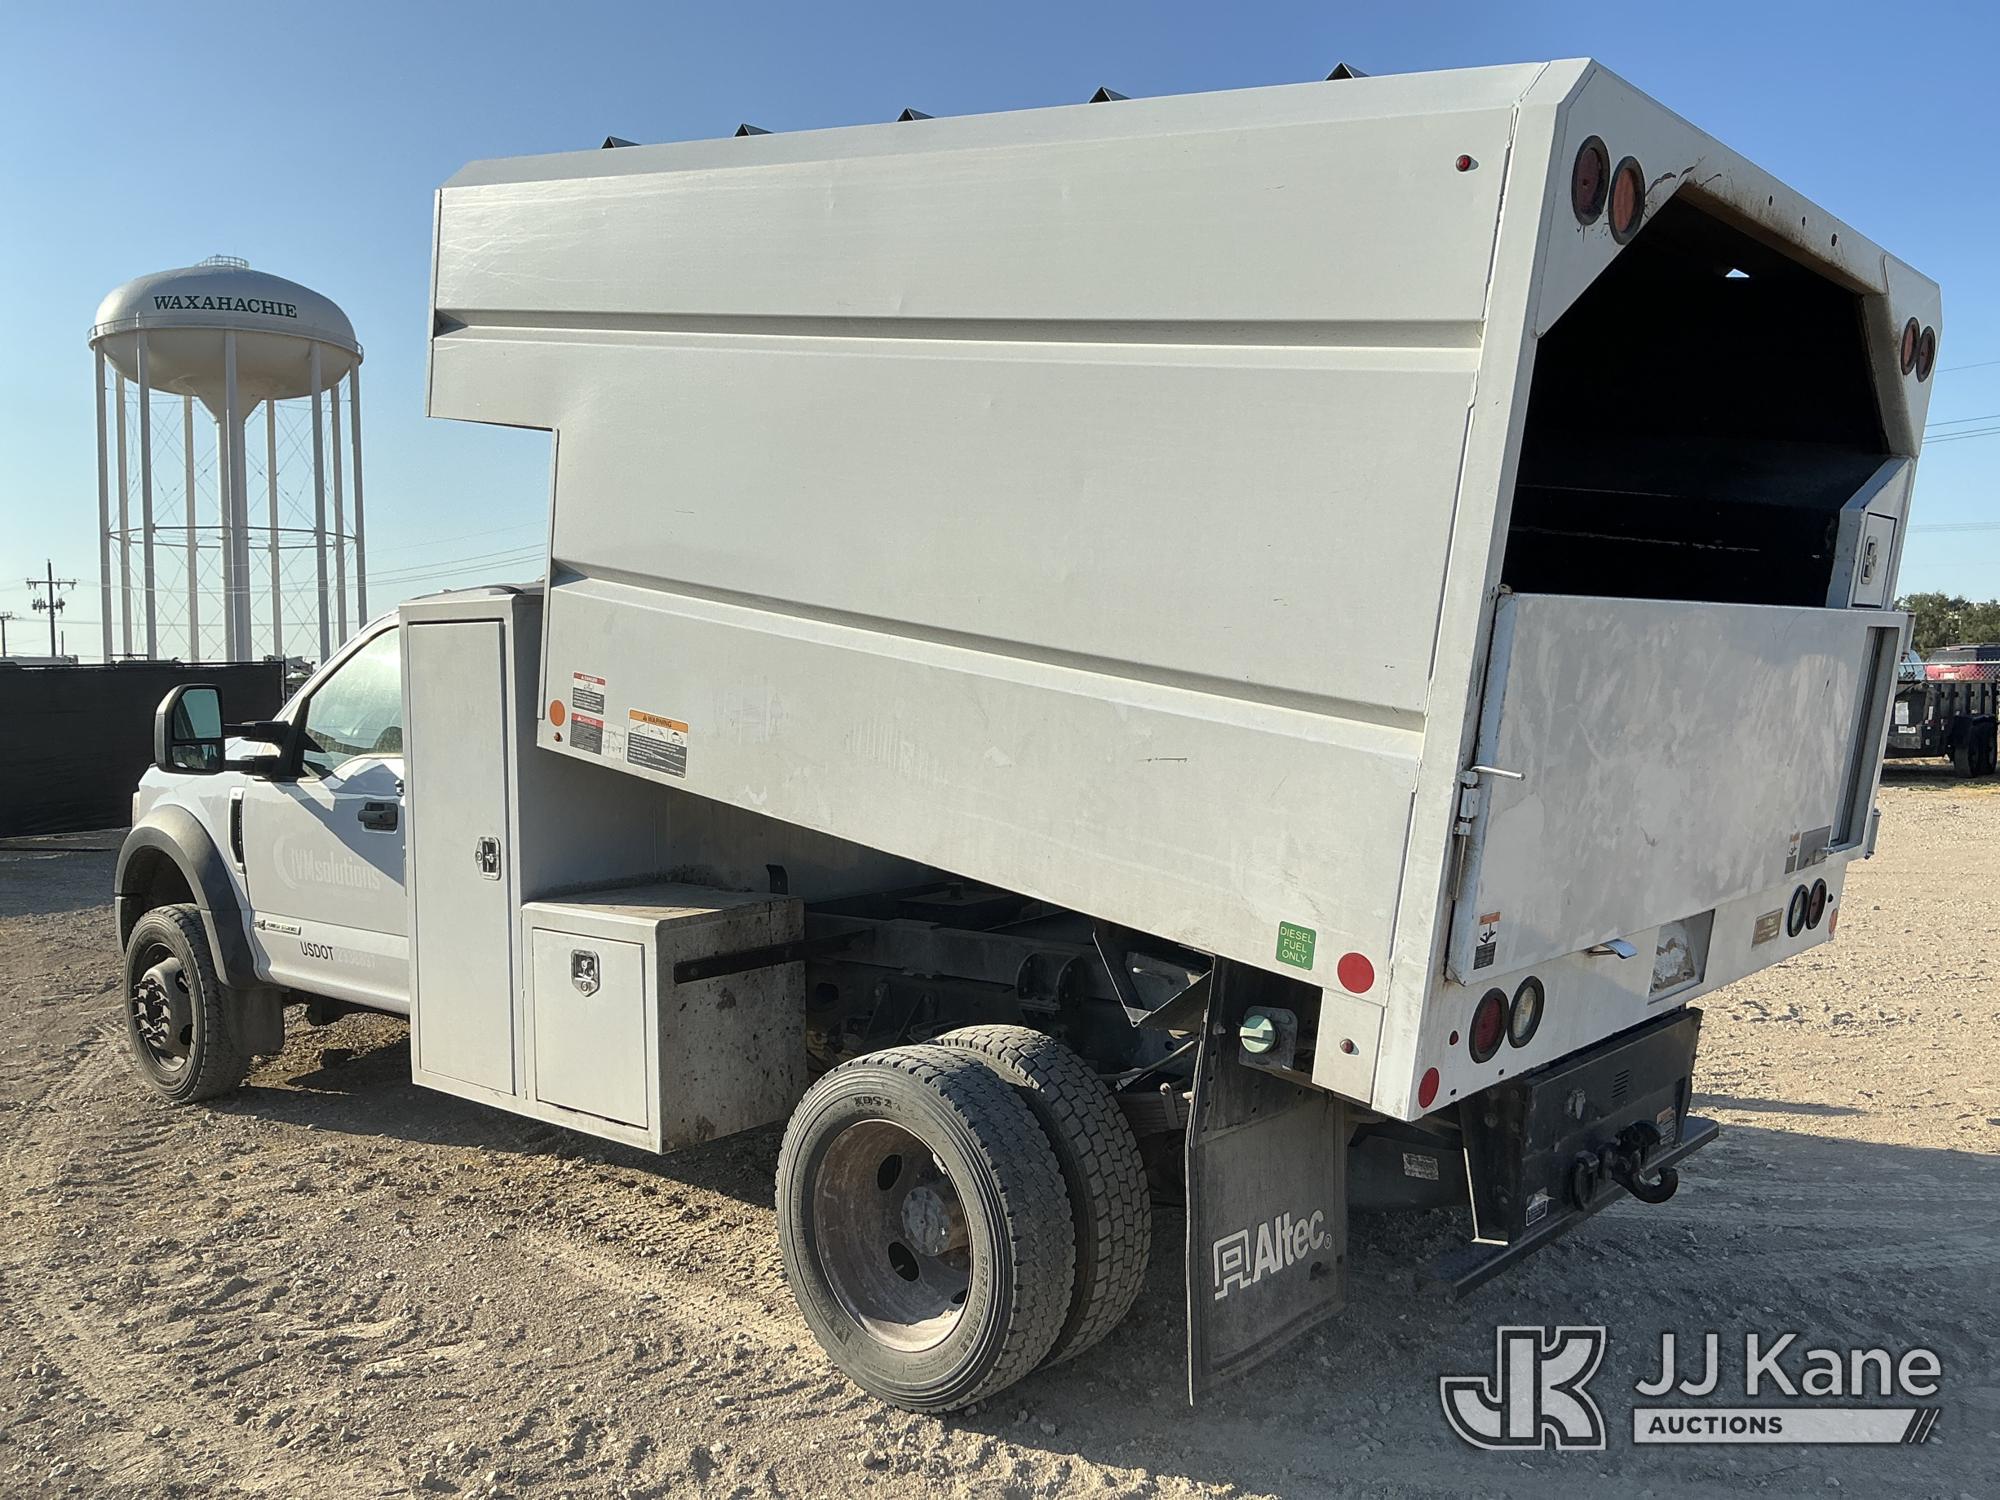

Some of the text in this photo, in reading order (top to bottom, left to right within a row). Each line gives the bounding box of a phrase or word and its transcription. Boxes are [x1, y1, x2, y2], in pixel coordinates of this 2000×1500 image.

[154, 295, 298, 318] WAXAHACHIE
[1280, 926, 1312, 944] DIESEL
[300, 941, 333, 960] USDOT
[1283, 938, 1307, 953] FUEL
[1282, 949, 1307, 964] ONLY
[1252, 1210, 1325, 1283] Altec
